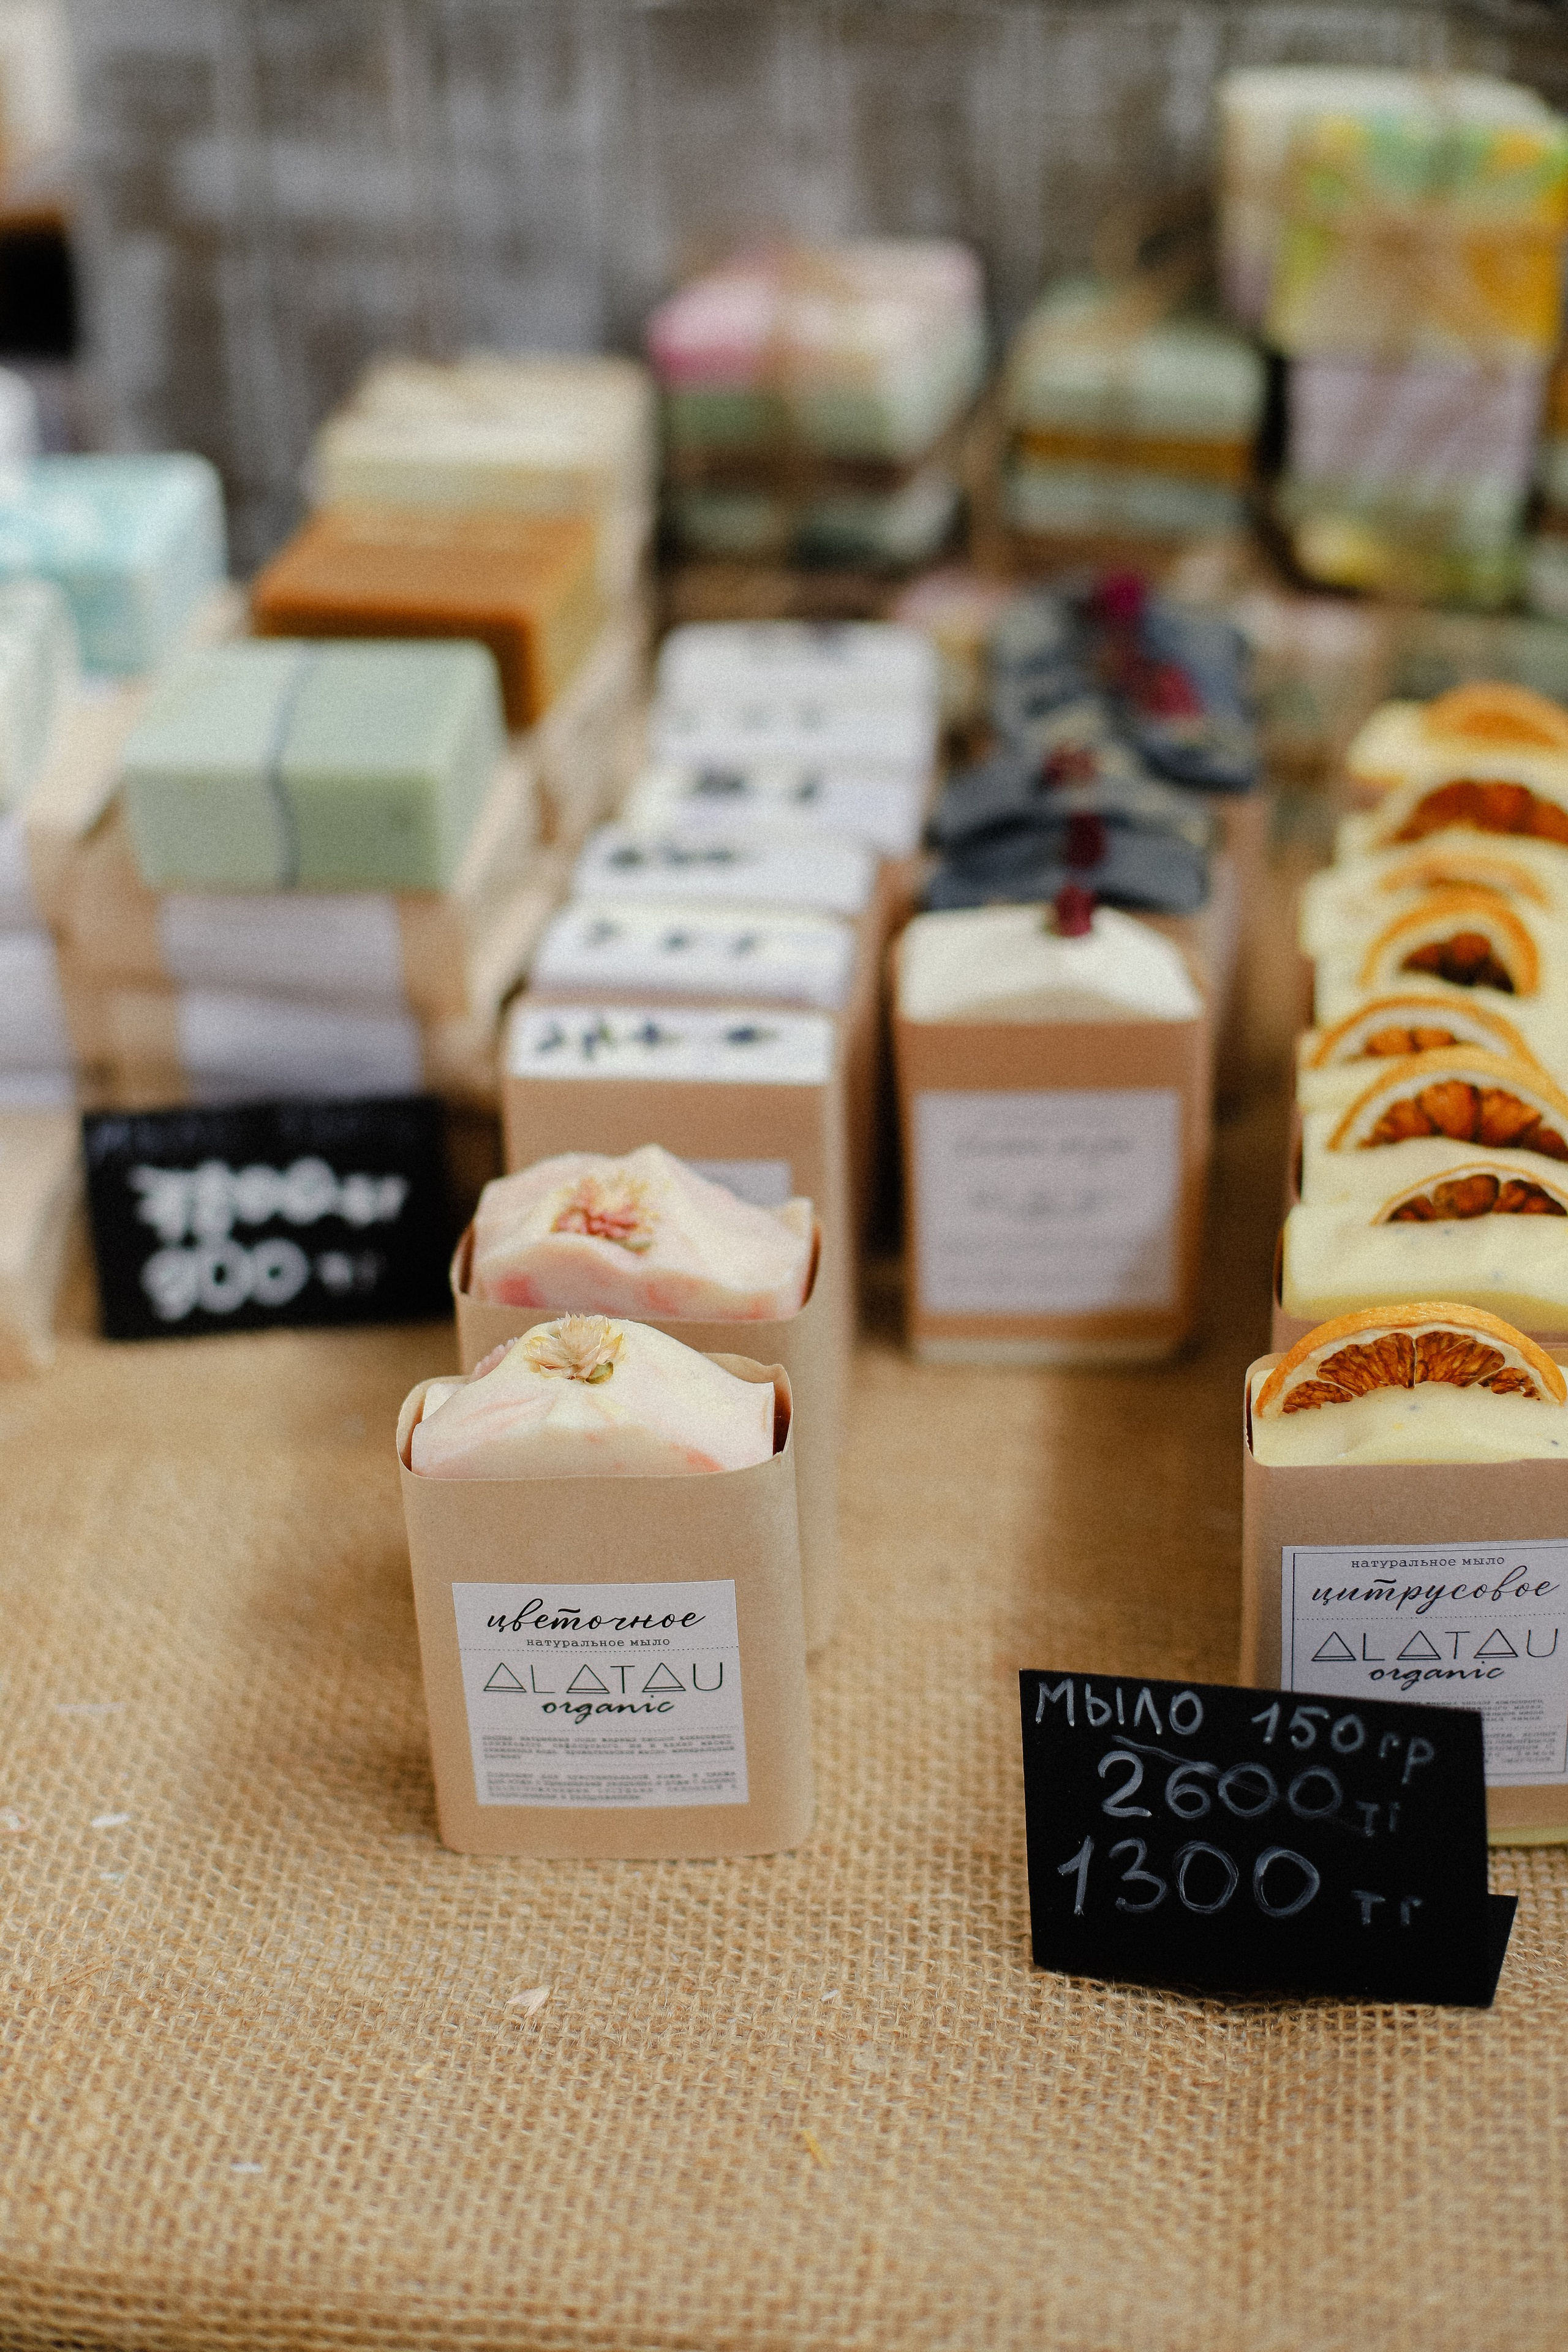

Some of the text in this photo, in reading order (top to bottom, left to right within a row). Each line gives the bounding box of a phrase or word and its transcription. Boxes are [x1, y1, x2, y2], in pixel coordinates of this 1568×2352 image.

[1351, 1556, 1505, 1569] натуральное мыло
[1311, 1565, 1560, 1615] цитрусовое
[487, 1597, 706, 1633] цветочное
[526, 1638, 670, 1649] натуральное мыло
[1311, 1628, 1559, 1662] ALATAU
[483, 1662, 724, 1695] ALATAU
[1368, 1660, 1504, 1691] organic
[541, 1695, 674, 1724] organic
[1251, 1701, 1366, 1754] 150
[1097, 1749, 1343, 1819] 2600
[1057, 1836, 1321, 1917] 1300
